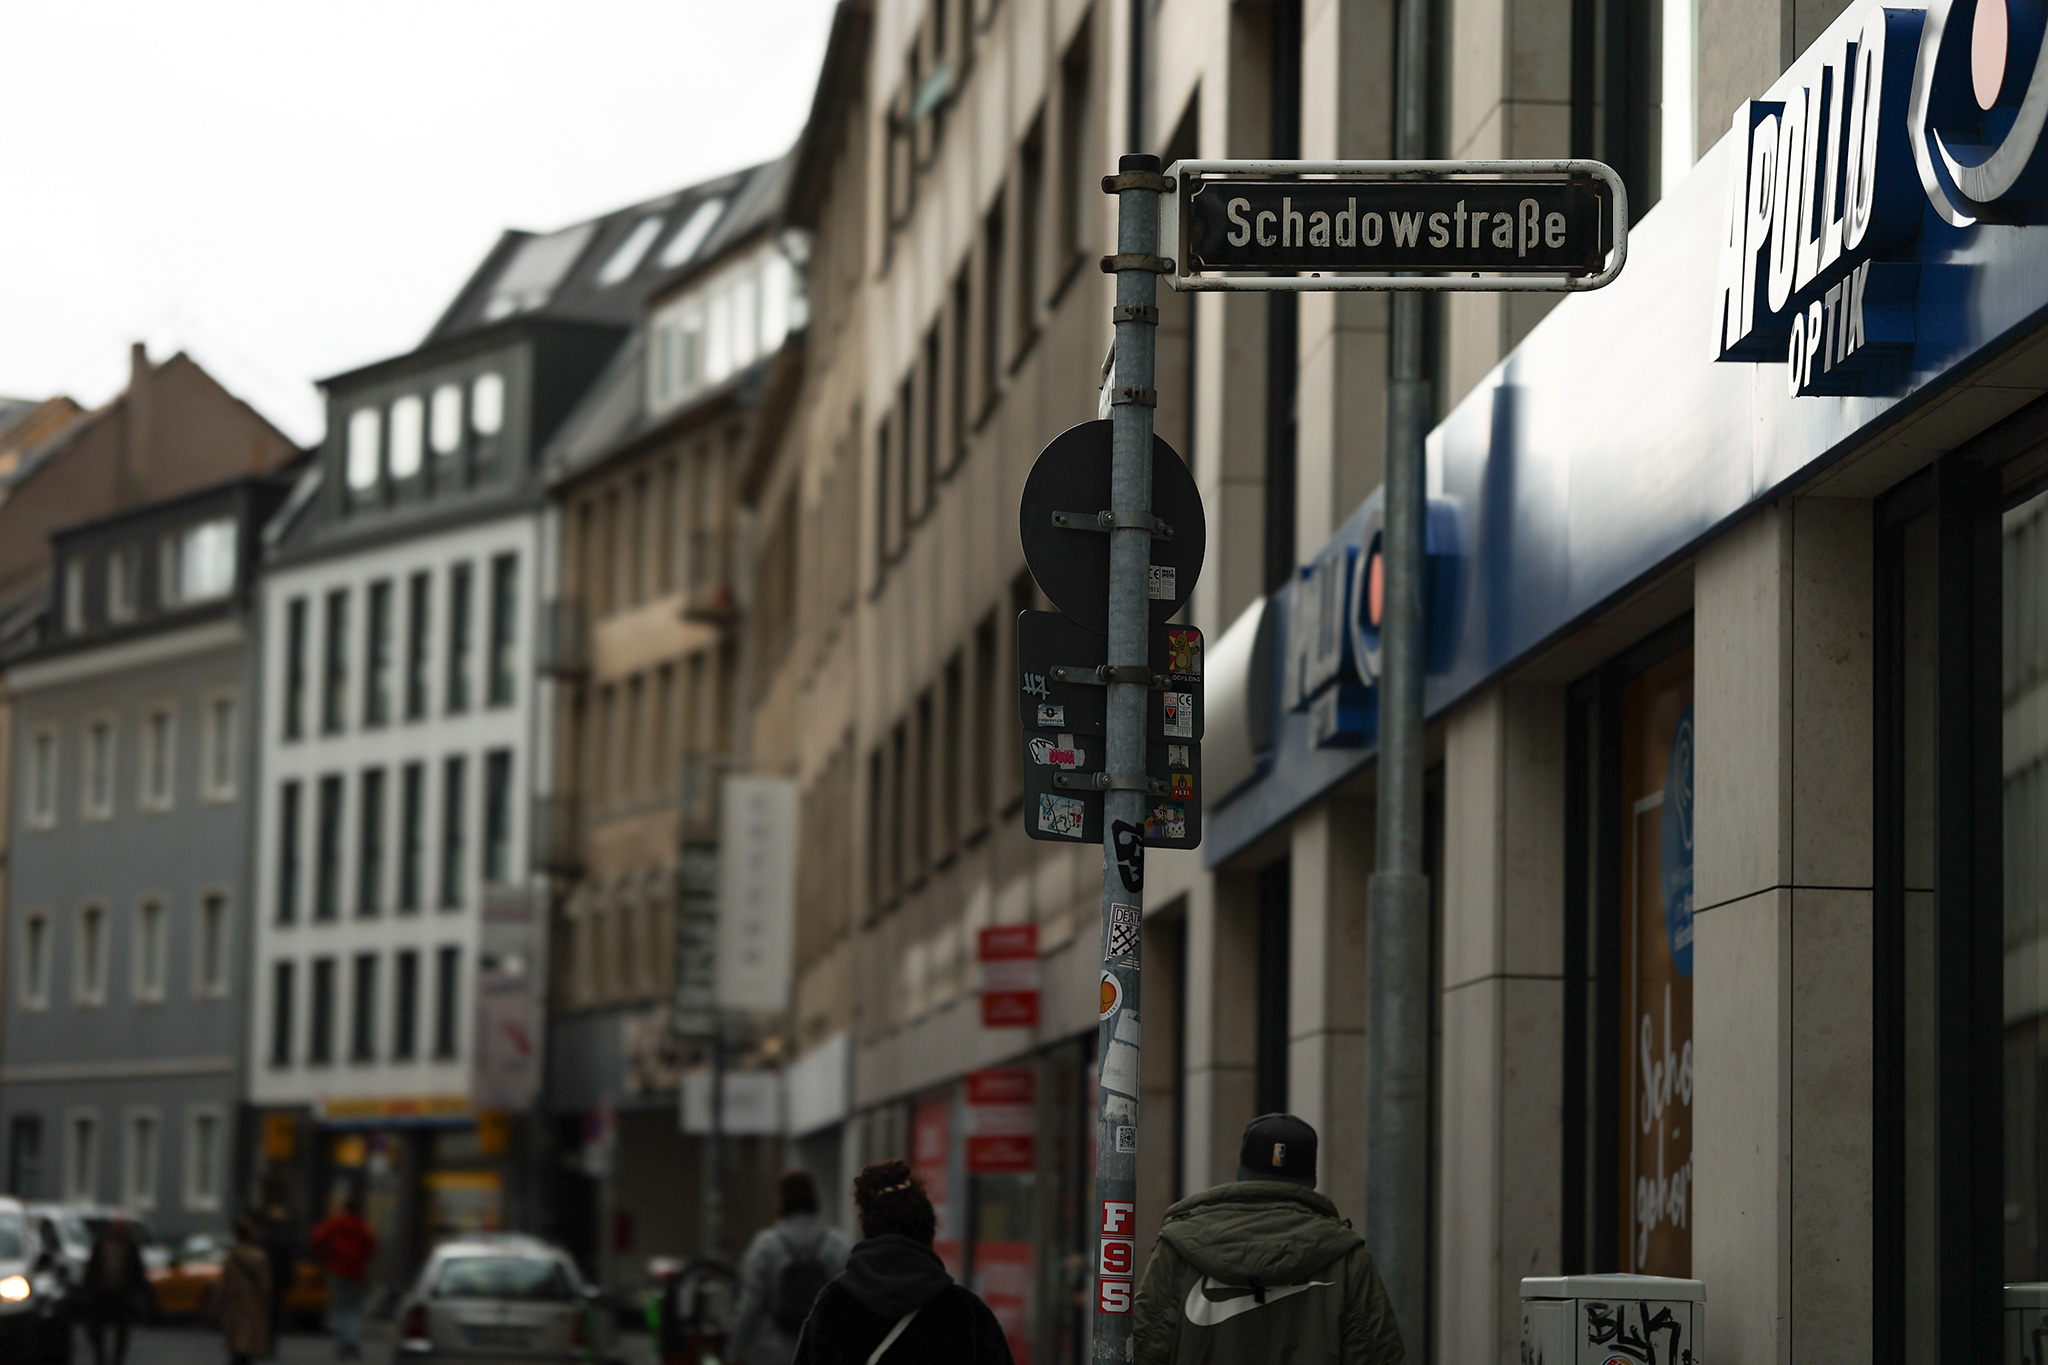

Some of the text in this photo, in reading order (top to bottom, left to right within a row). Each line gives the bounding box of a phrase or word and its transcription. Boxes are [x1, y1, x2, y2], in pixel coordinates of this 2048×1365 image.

[1227, 197, 1566, 258] Schadowstraße
[1709, 5, 1887, 366] APOLLO
[1788, 258, 1871, 399] OPTIK
[1179, 694, 1191, 706] CE
